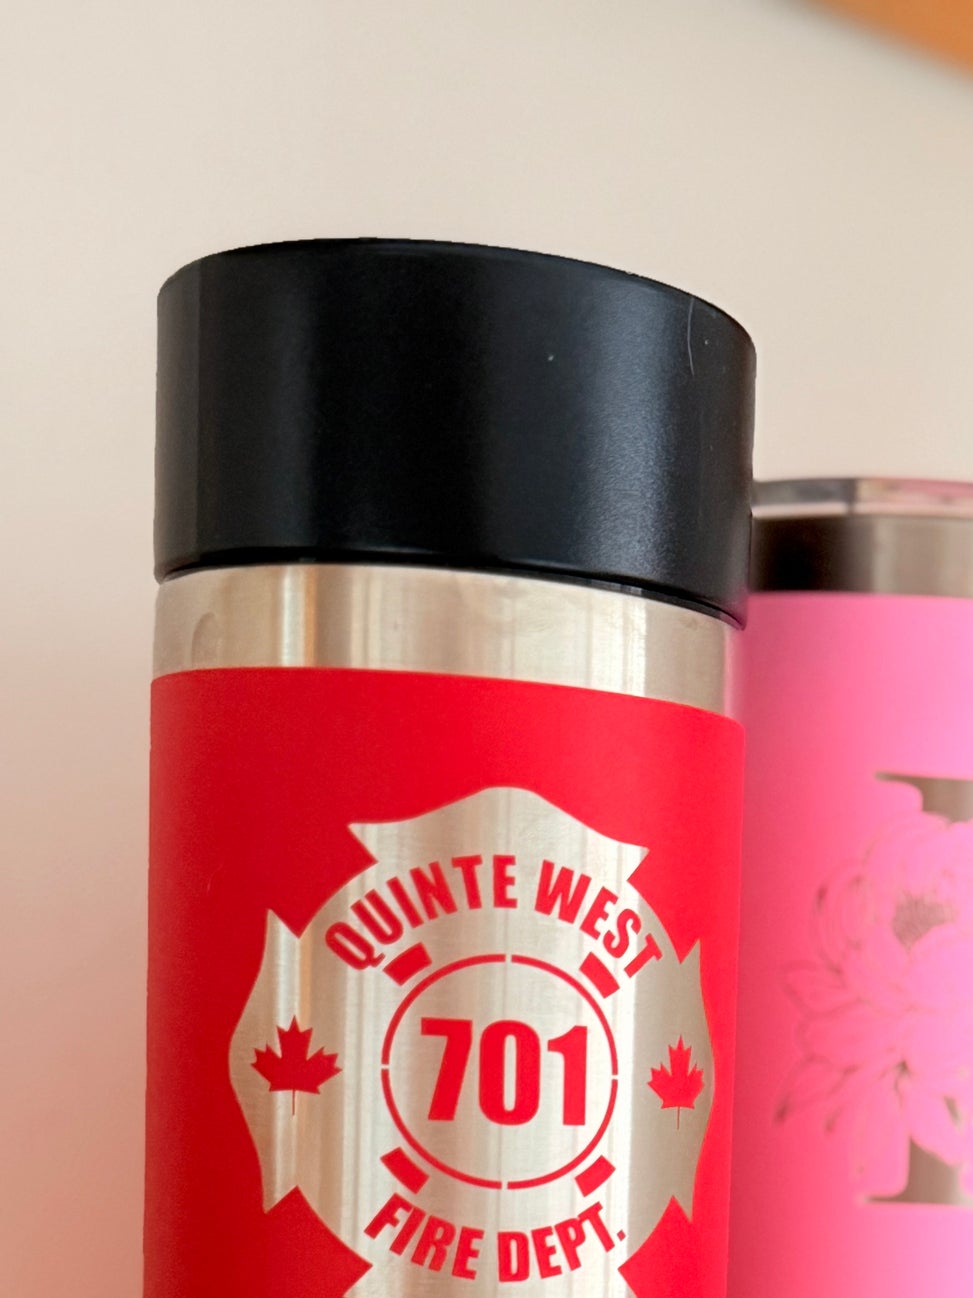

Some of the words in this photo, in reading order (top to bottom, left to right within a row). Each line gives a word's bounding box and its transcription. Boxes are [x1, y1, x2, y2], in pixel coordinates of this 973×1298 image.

[325, 853, 519, 971] QUINTE
[535, 859, 663, 979] WEST
[420, 1016, 589, 1127] 701
[363, 1192, 486, 1281] FIRE
[497, 1201, 628, 1284] DEPT.
